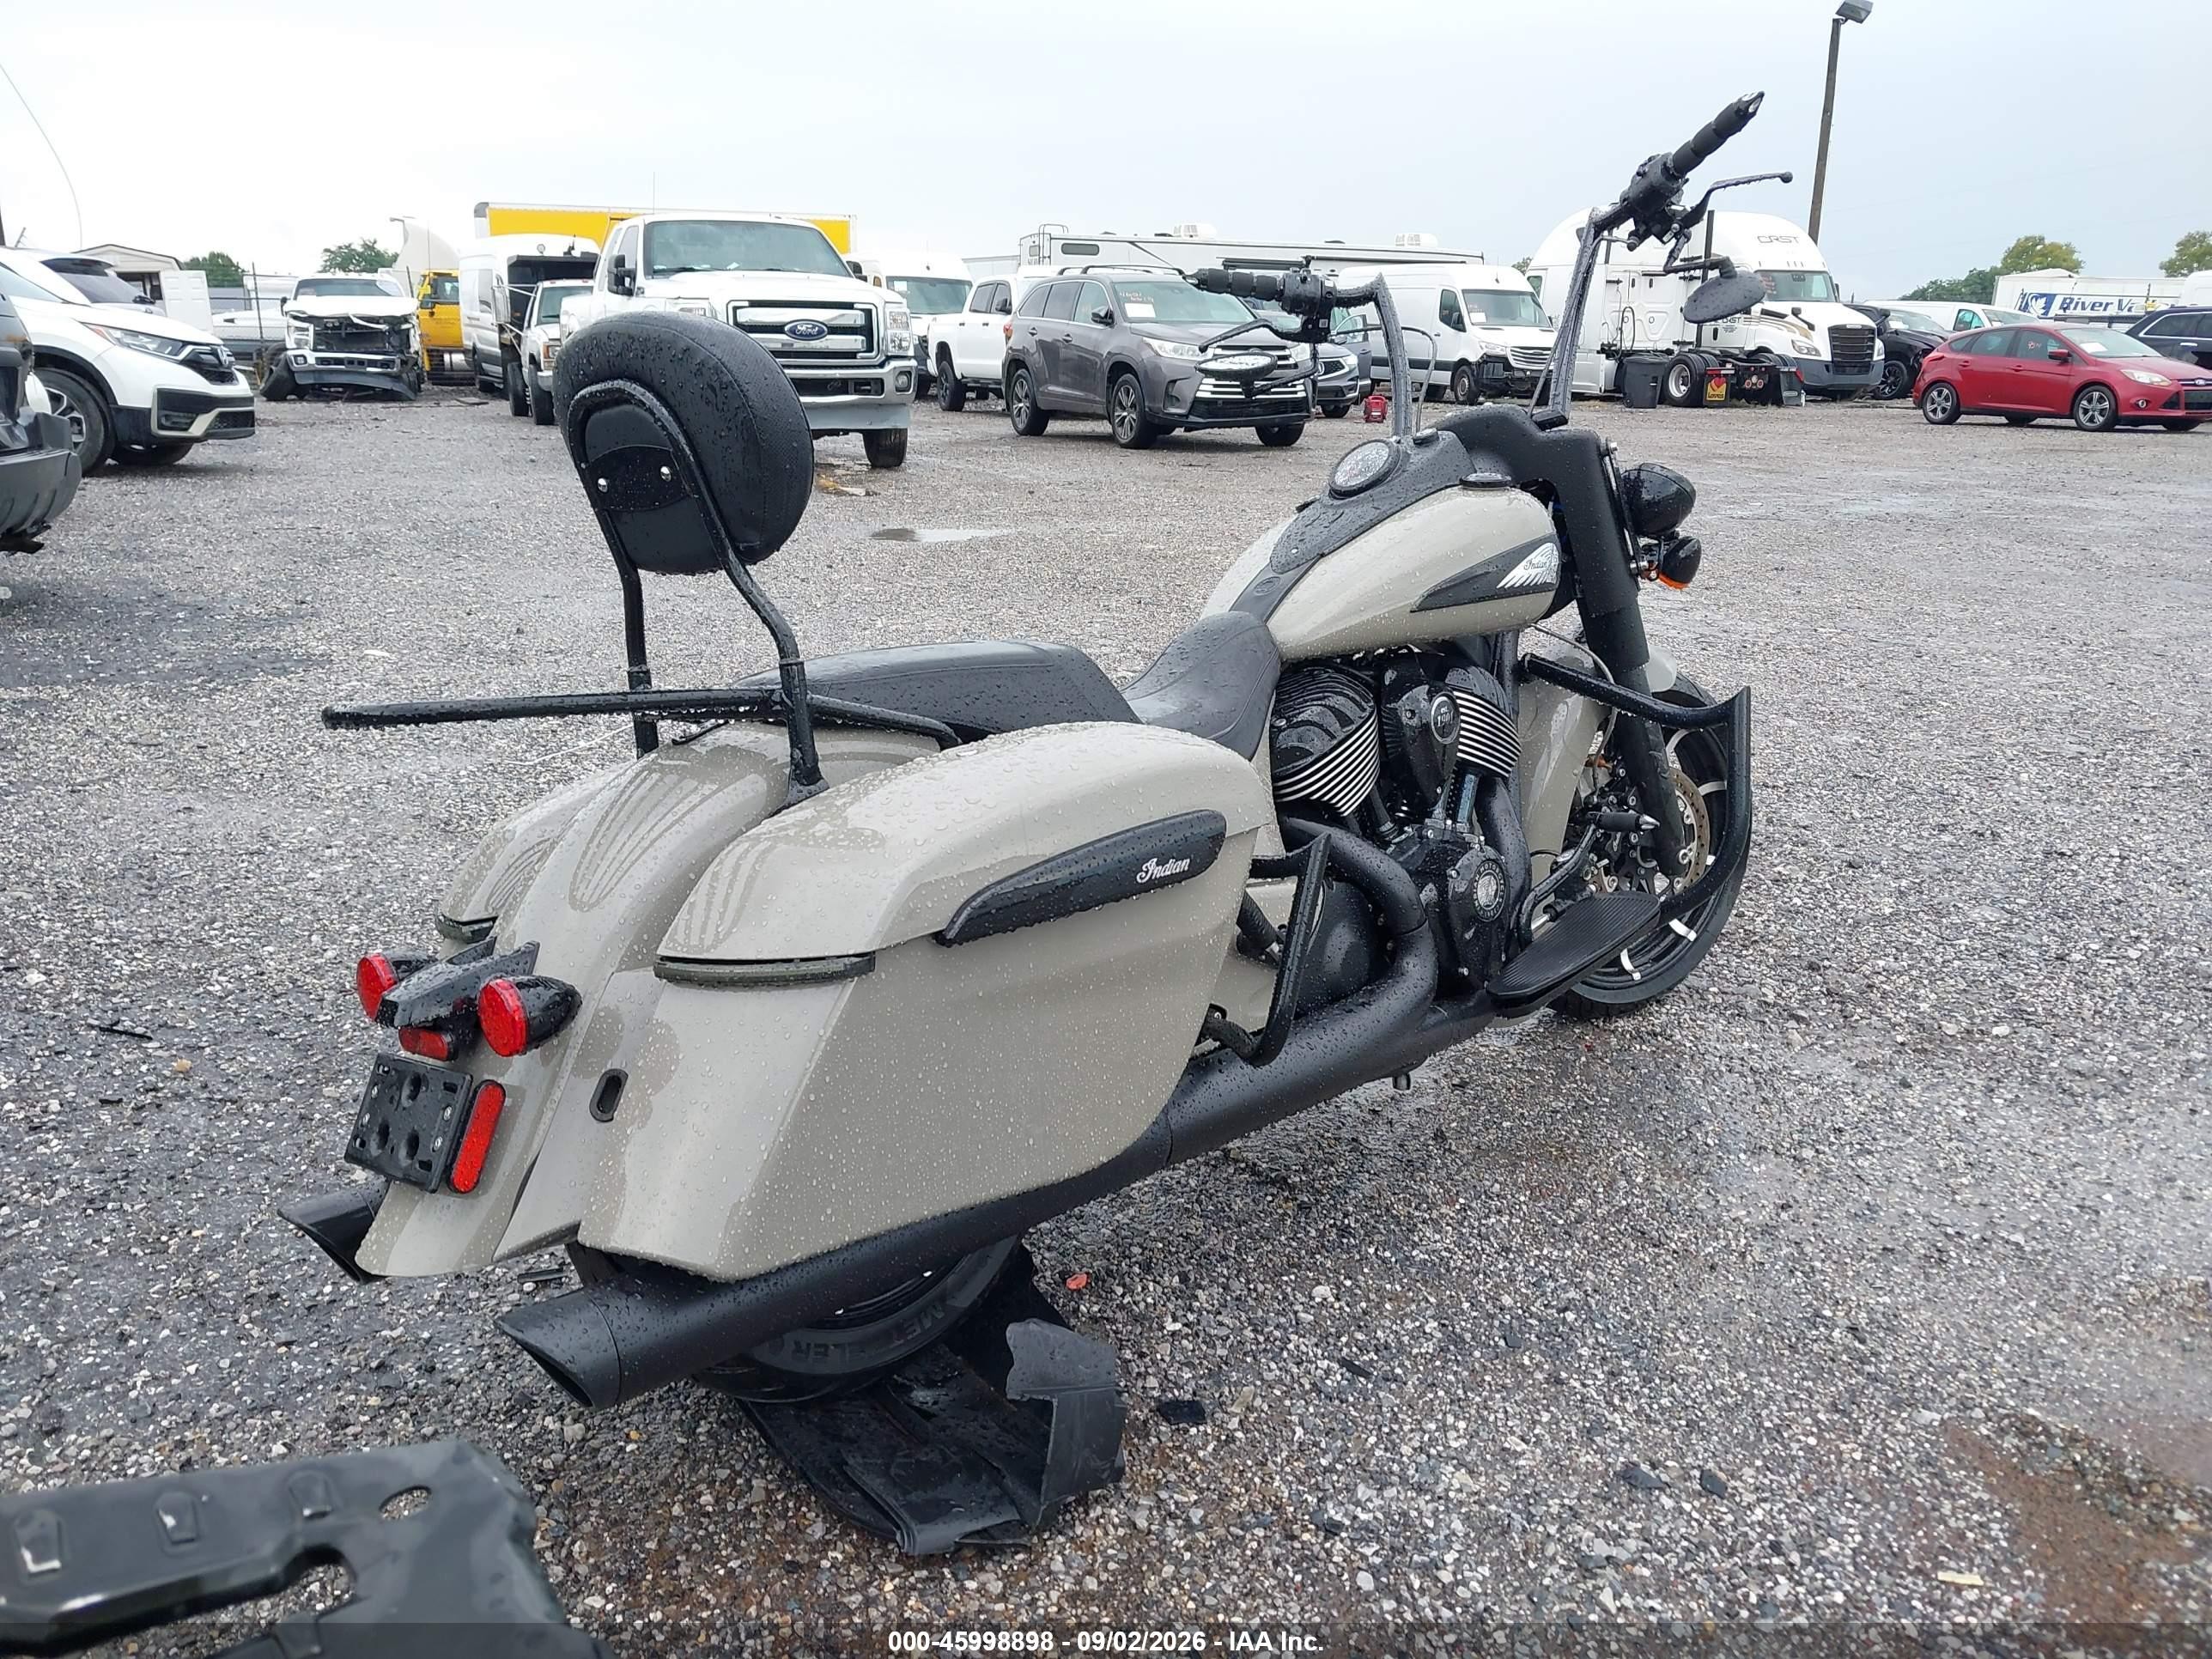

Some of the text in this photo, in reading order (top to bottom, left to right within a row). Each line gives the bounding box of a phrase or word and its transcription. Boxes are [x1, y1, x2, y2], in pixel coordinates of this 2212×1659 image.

[1757, 235, 1800, 244] CRST
[2060, 296, 2113, 313] River
[795, 324, 818, 335] Ford
[1136, 857, 1190, 884] Indian
